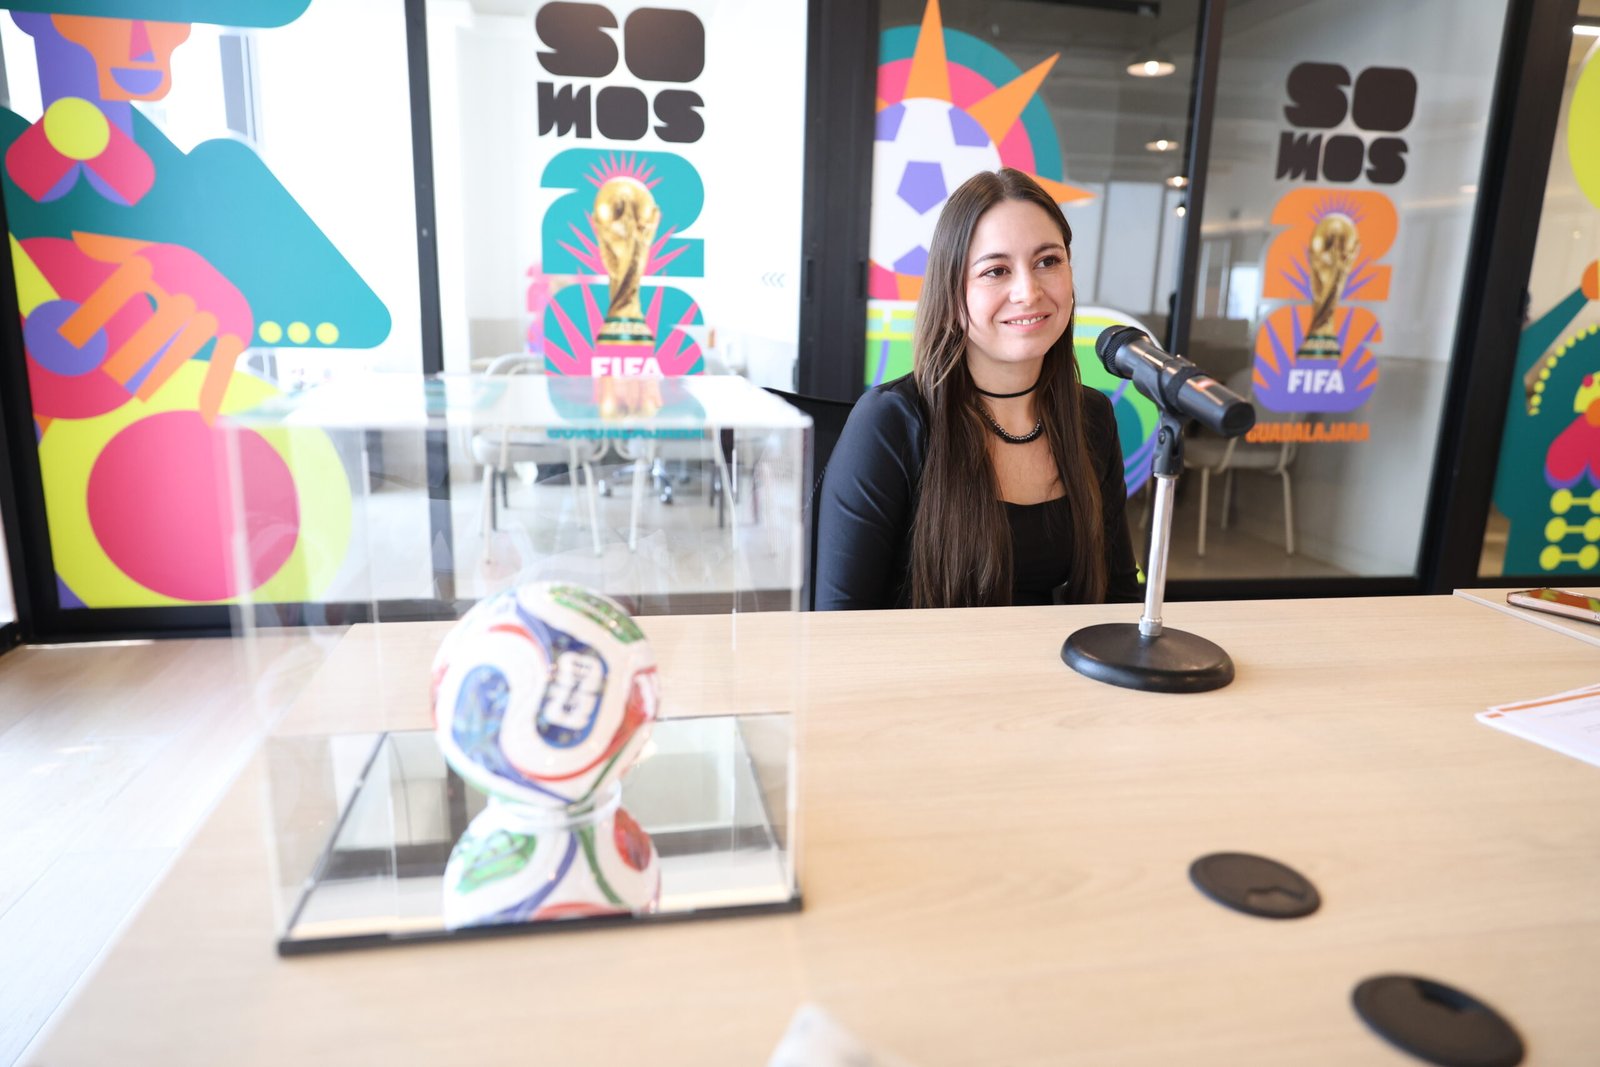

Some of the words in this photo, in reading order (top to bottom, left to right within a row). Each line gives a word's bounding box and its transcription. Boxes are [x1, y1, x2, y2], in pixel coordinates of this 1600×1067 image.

[536, 1, 705, 83] SO
[537, 81, 705, 143] MOS
[1283, 61, 1418, 132] SO
[1275, 131, 1409, 184] MOS
[591, 356, 664, 378] FIFA
[1287, 369, 1345, 394] FIFA
